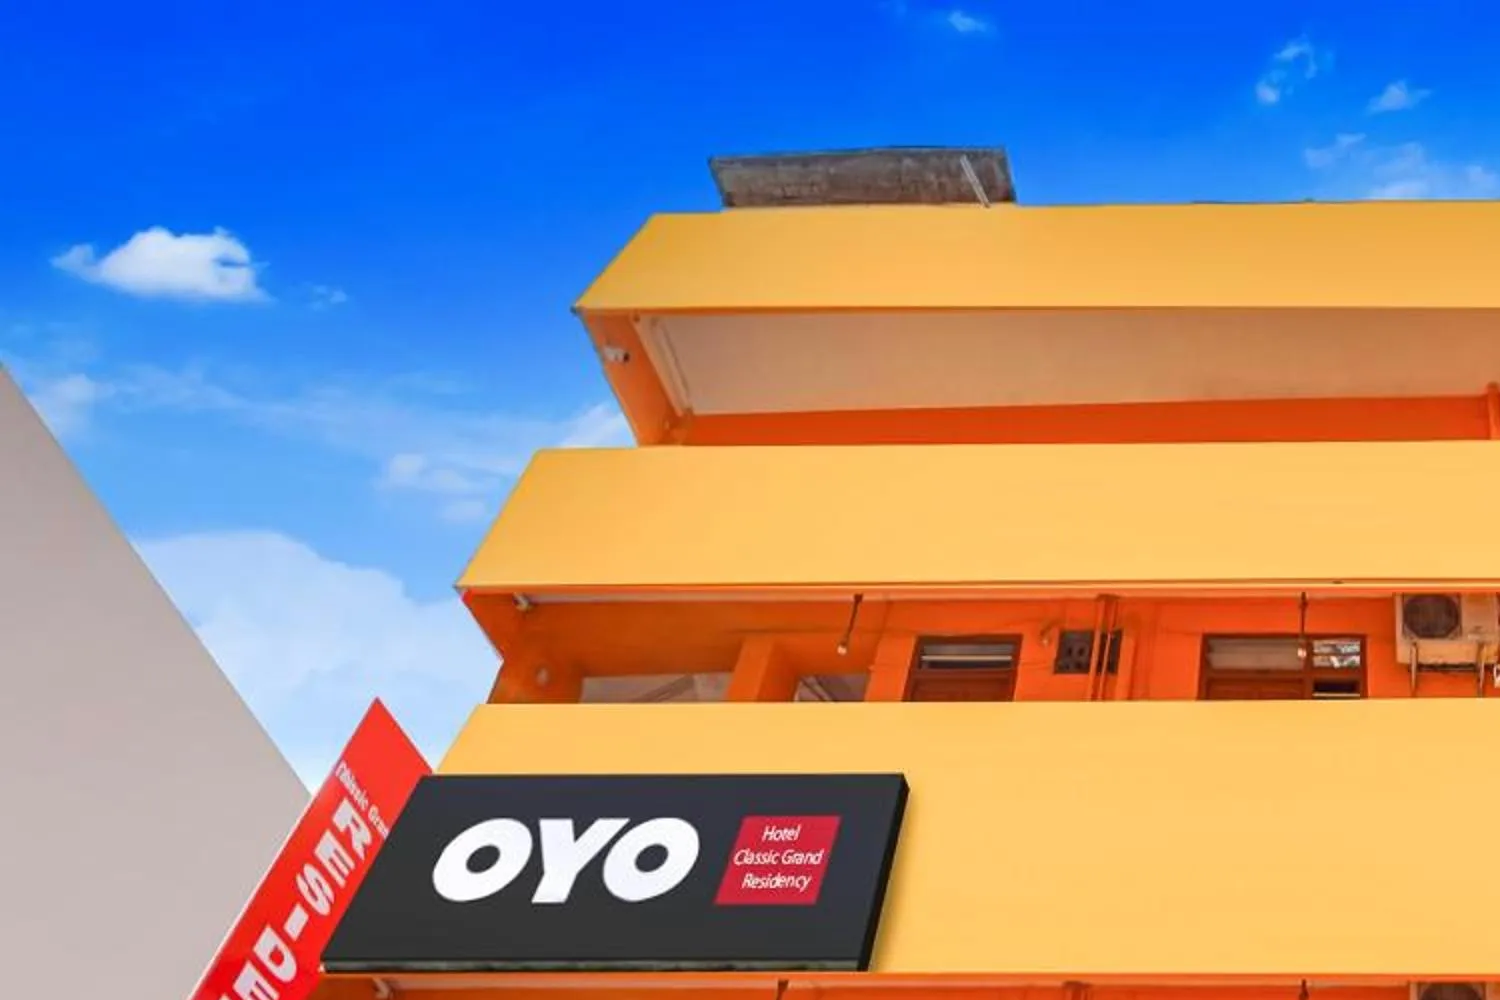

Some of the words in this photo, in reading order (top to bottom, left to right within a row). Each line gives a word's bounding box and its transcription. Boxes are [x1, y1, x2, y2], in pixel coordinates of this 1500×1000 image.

[762, 823, 801, 841] Hotel
[432, 816, 701, 904] OYO
[733, 847, 780, 866] Classic
[781, 847, 824, 865] Grand
[742, 872, 812, 892] Residency
